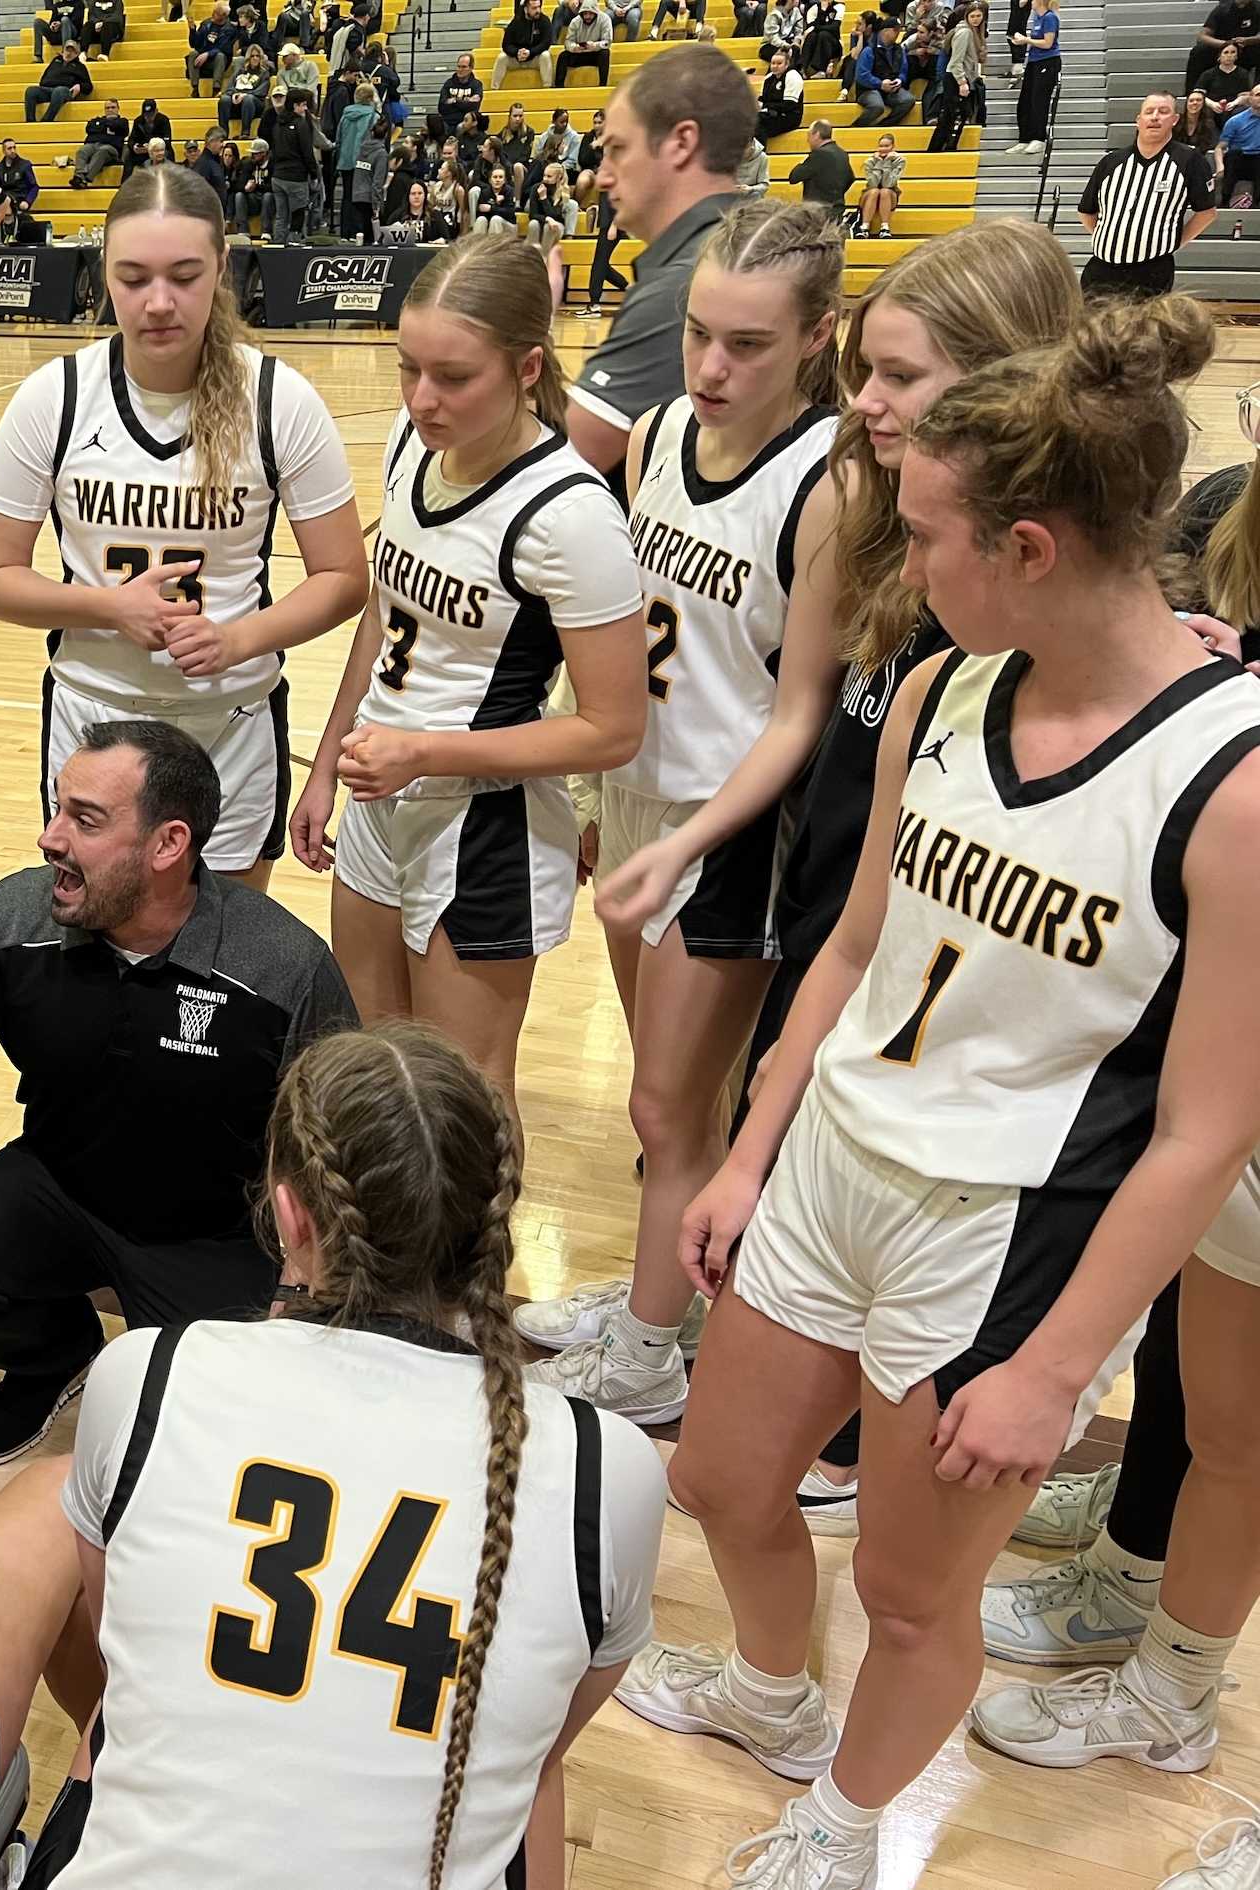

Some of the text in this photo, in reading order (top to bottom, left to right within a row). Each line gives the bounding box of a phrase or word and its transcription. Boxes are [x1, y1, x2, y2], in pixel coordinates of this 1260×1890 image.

[306, 256, 392, 285] OSAA
[306, 284, 383, 293] STATE CHAMPIONSHIPS
[341, 294, 373, 304] OnPoint
[74, 478, 248, 530] WARRIORS
[378, 604, 421, 695] 3
[644, 596, 681, 704] 2
[176, 984, 228, 1005] PHILOMATH
[875, 937, 965, 1068] 1
[160, 1037, 220, 1057] BASKETBALL
[204, 1456, 467, 1742] 34
